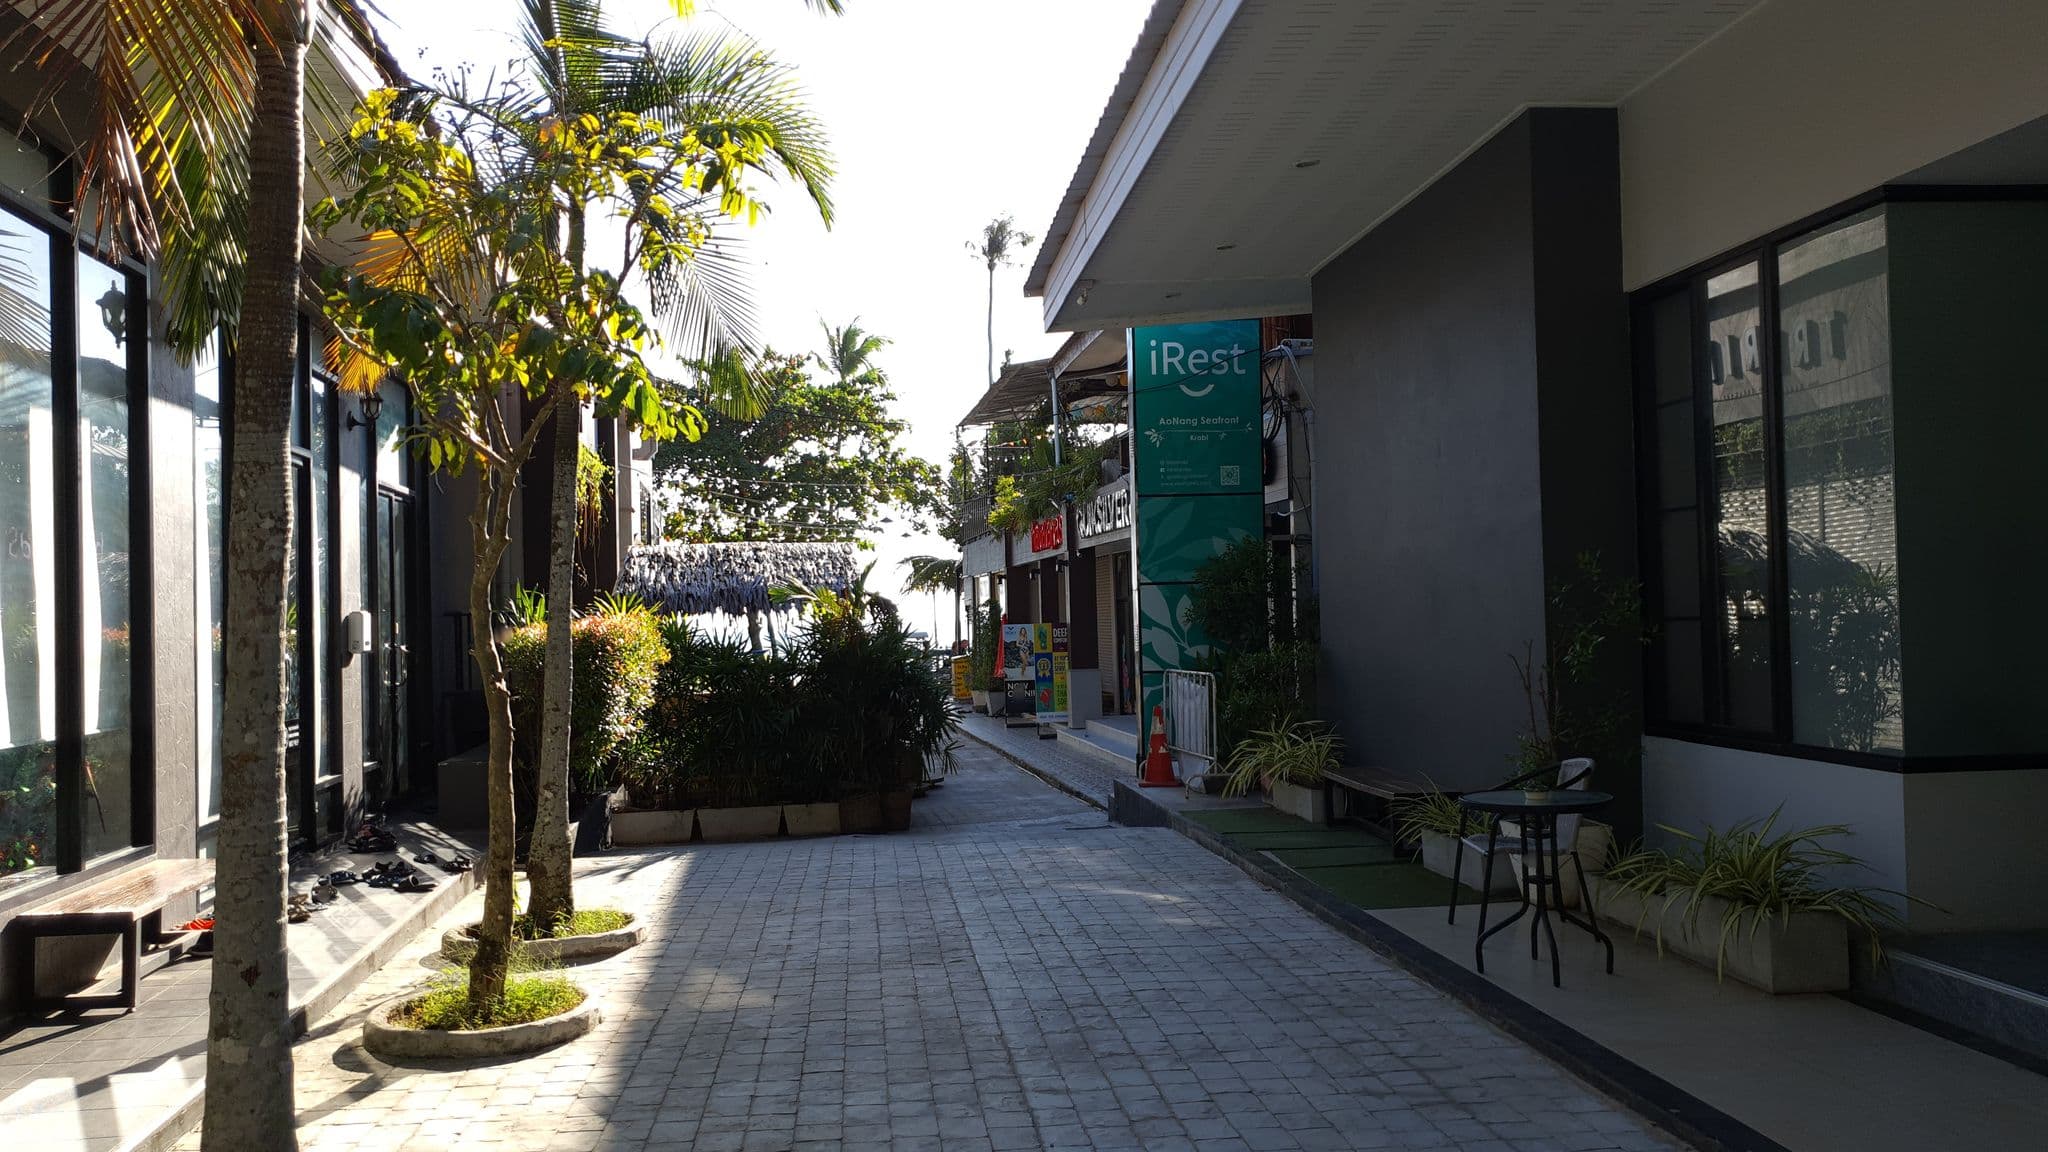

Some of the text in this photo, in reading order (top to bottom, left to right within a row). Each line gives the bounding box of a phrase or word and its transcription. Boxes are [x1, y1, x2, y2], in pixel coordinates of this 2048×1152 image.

[1150, 339, 1246, 376] iRest
[1159, 415, 1240, 427] AoNang Seafront
